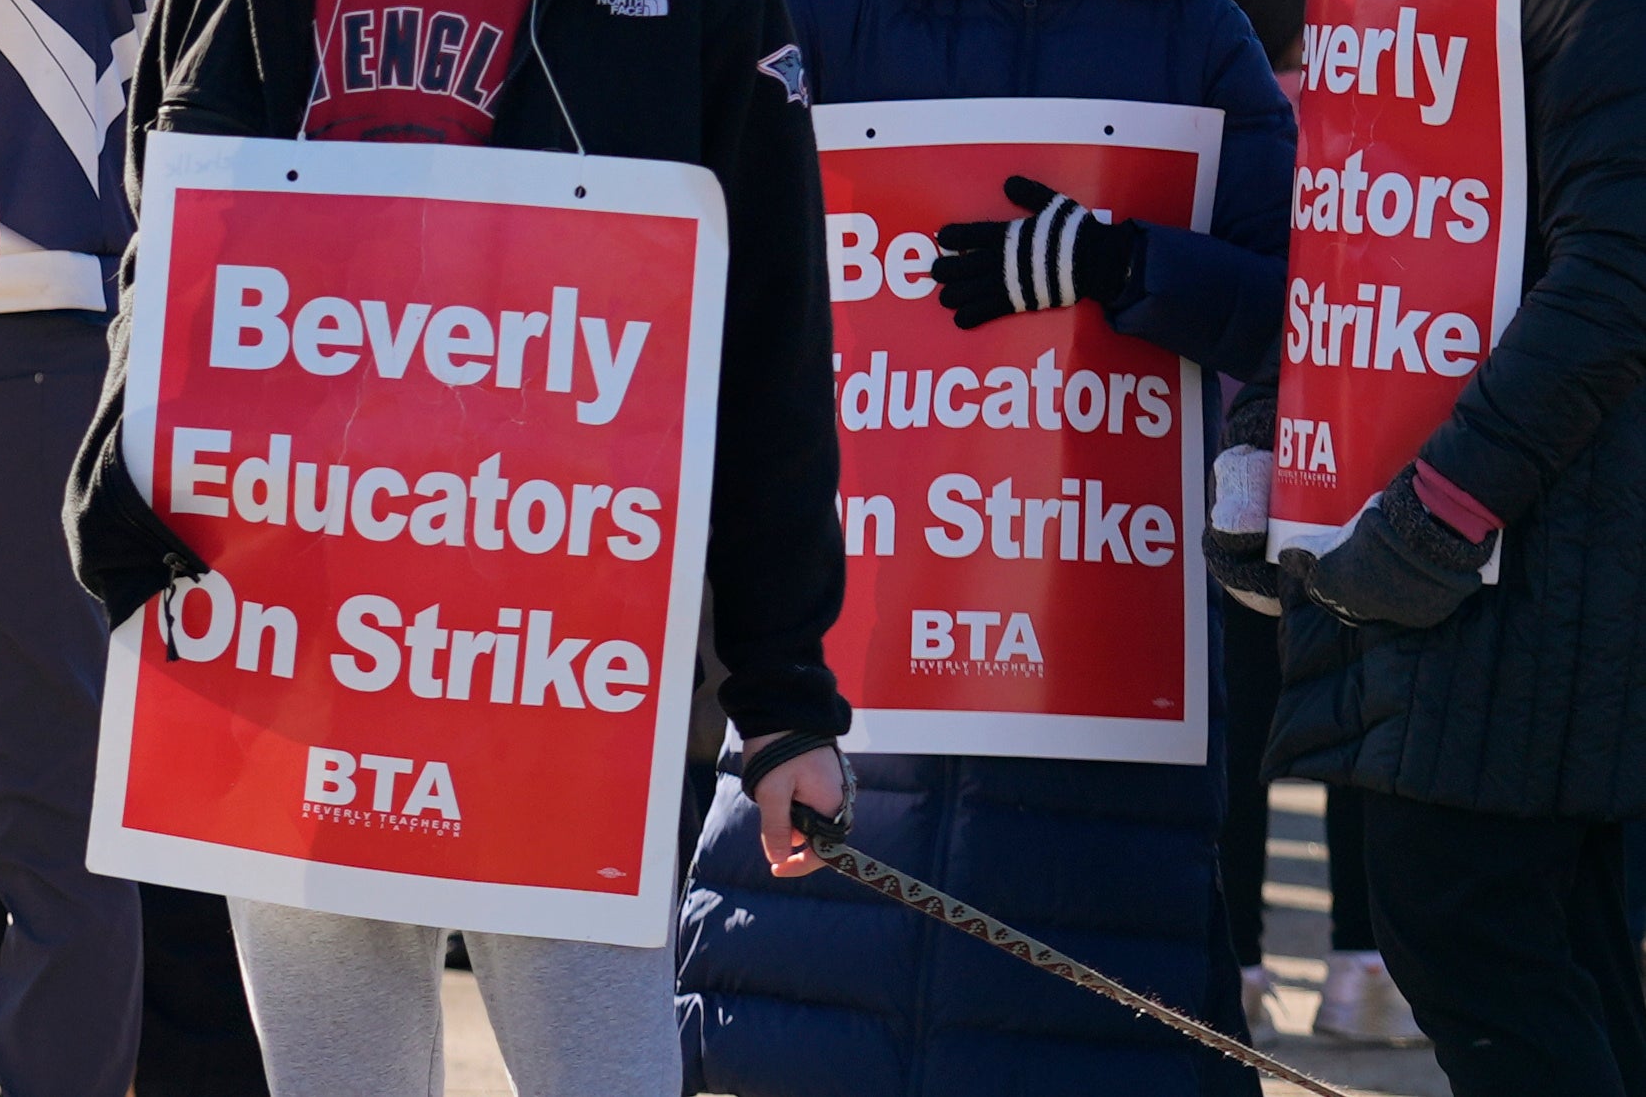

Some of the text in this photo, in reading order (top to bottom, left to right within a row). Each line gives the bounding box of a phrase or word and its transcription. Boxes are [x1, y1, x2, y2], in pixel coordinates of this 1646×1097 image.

[609, 5, 643, 17] FACE
[1291, 149, 1491, 244] cators
[209, 264, 651, 426] Beverly
[1287, 276, 1481, 377] Strike
[1278, 416, 1337, 474] BTA
[170, 427, 662, 561] Educators
[835, 473, 1176, 568] n Strike
[157, 568, 650, 713] On Strike
[911, 609, 1044, 663] BTA
[302, 802, 462, 832] BEVERLY TEACHERS
[302, 812, 460, 838] ASSOCIATION
[303, 746, 461, 821] BTA
